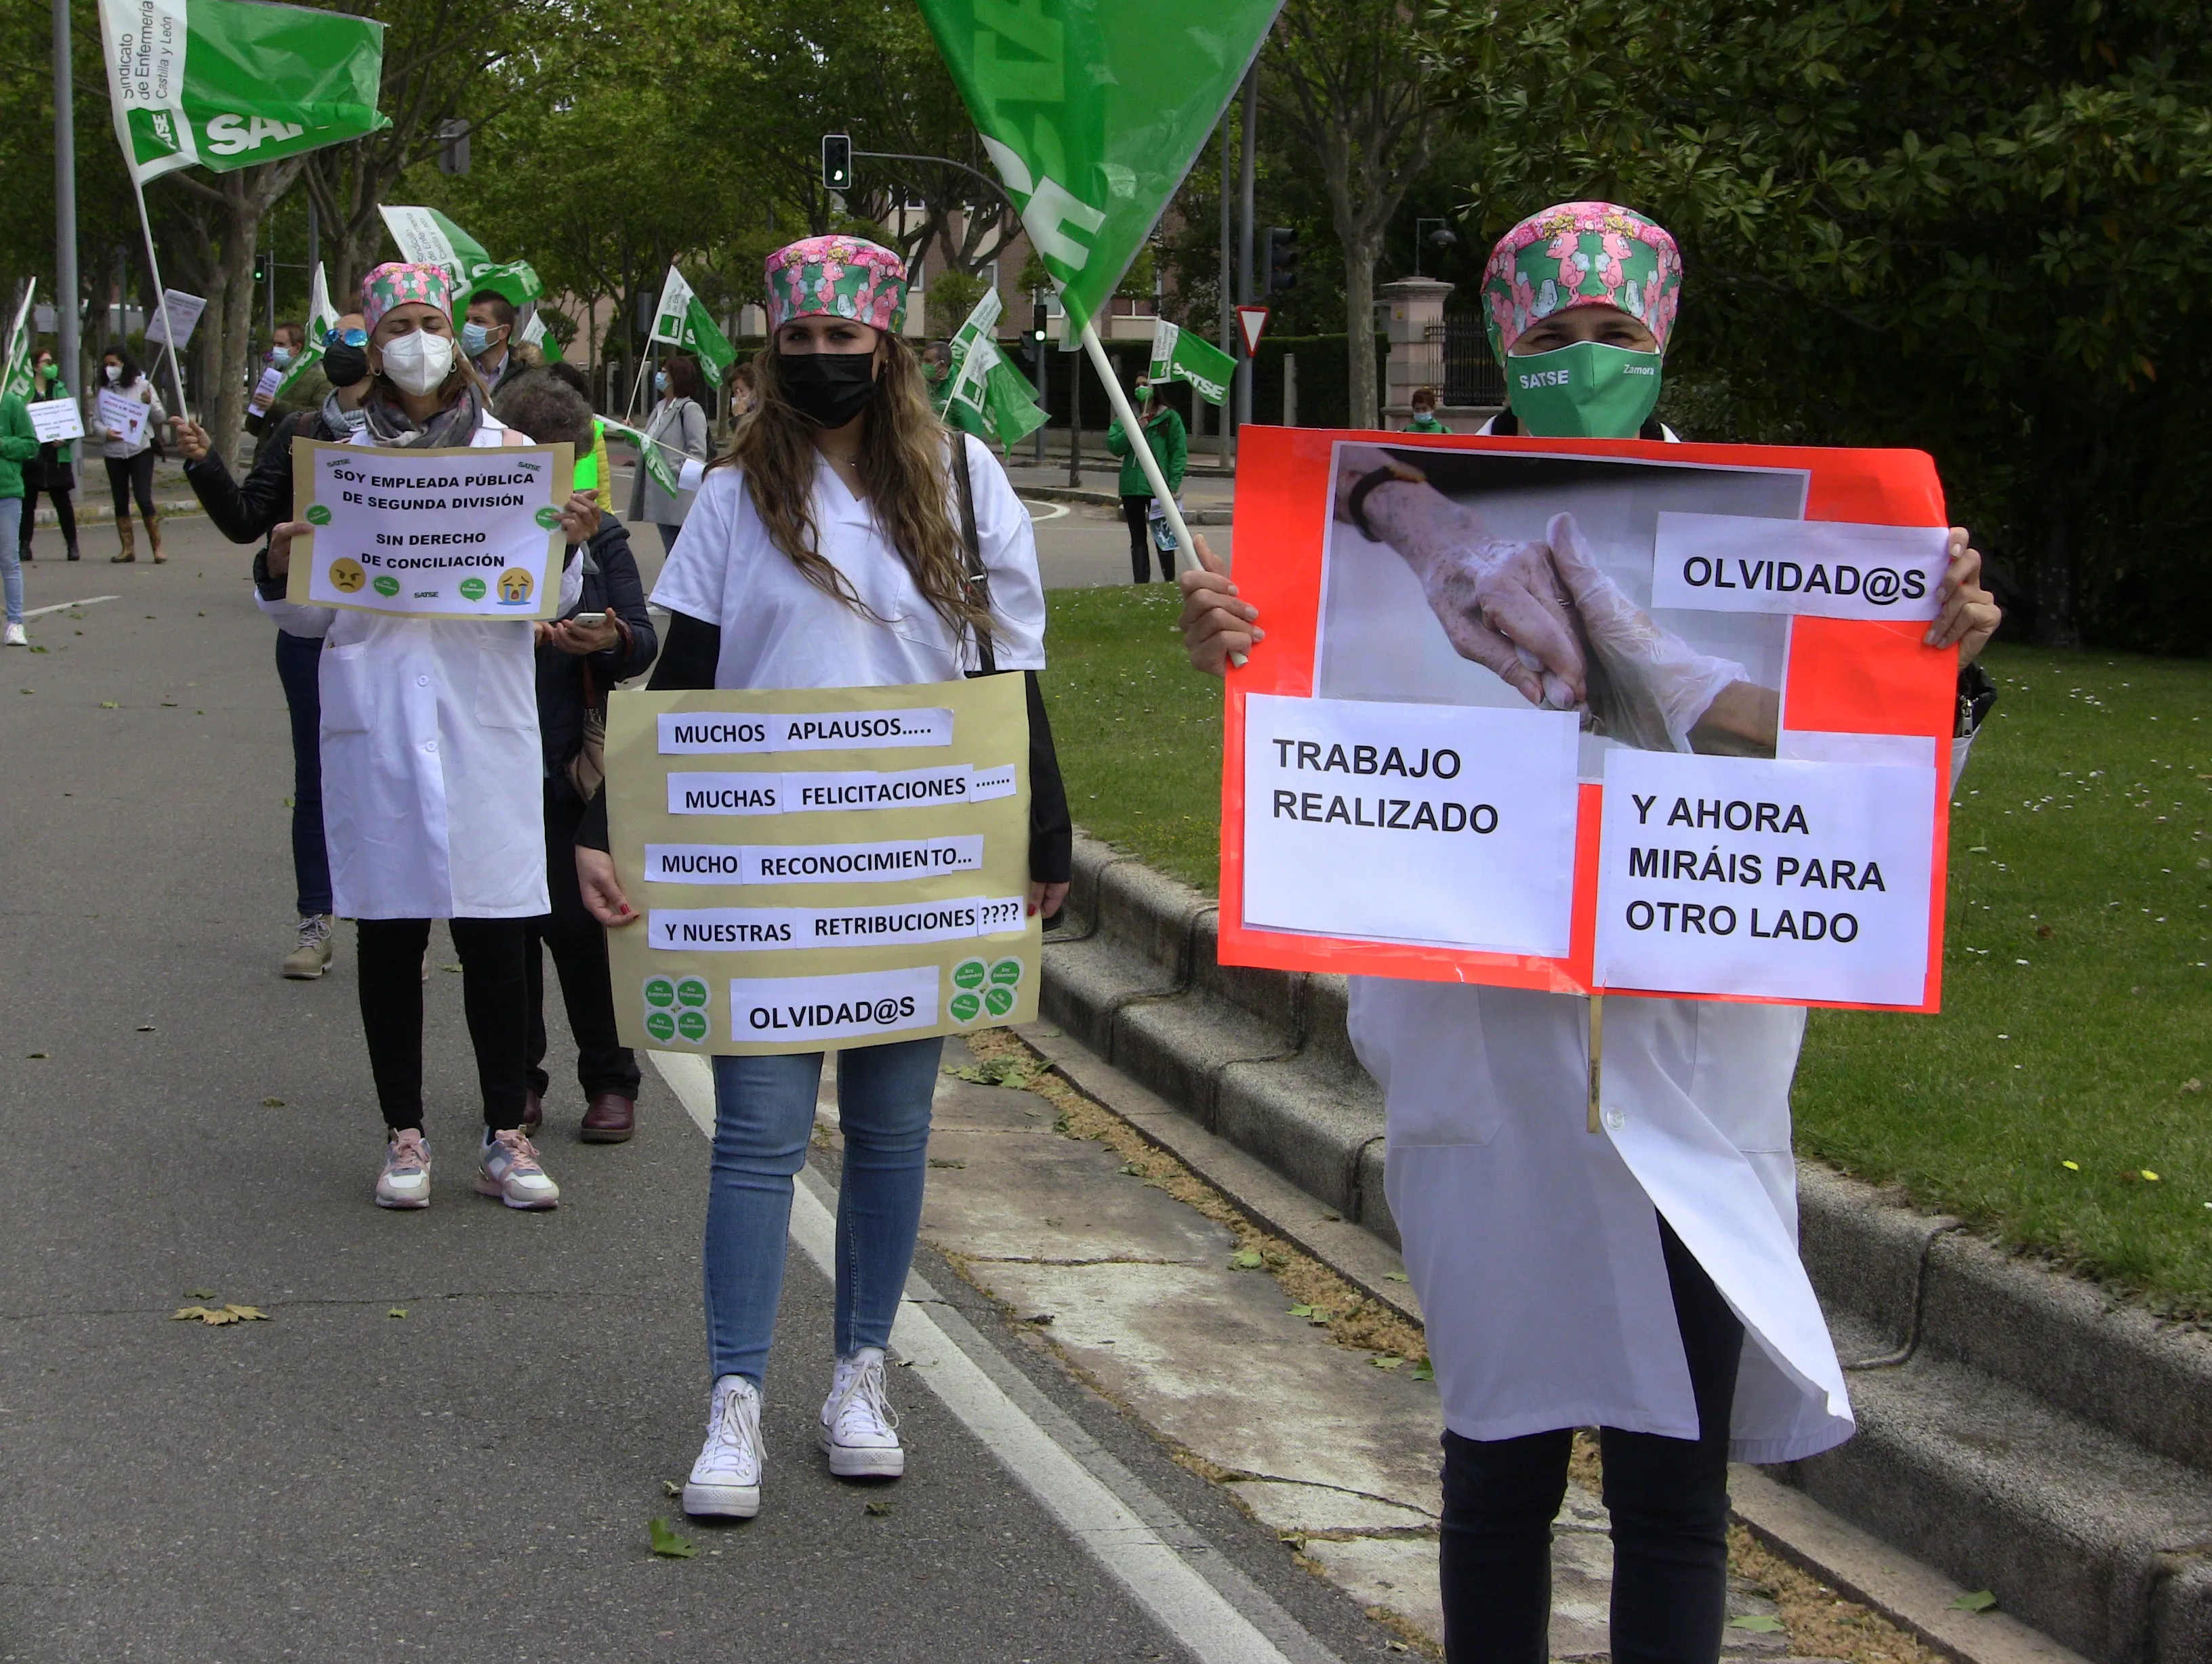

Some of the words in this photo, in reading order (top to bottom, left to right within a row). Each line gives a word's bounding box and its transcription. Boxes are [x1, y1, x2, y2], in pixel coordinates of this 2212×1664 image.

[135, 1, 153, 77] Enfermería
[160, 16, 172, 44] León
[117, 33, 134, 100] Sindicato
[161, 47, 173, 56] y
[138, 81, 150, 100] de
[156, 59, 169, 99] Castilla
[1519, 369, 1569, 390] SATSE
[1623, 364, 1655, 375] Zamora
[333, 469, 367, 484] SOY
[371, 476, 459, 488] EMPLEADA
[465, 472, 535, 487] PÚBLICA
[342, 491, 363, 505] DE
[367, 496, 447, 510] SEGUNDA
[452, 493, 524, 509] DIVISIÓN
[375, 533, 403, 546] SIN
[409, 533, 487, 545] DERECHO
[361, 553, 382, 566] DE
[386, 553, 505, 569] CONCILIACIÓN
[1683, 556, 1925, 606] OLVIDAD@S
[675, 724, 765, 743] MUCHOS
[1273, 739, 1460, 779] TRABAJO
[686, 789, 776, 809] MUCHAS
[802, 777, 966, 806] FELICITACIONES
[1273, 789, 1498, 834] REALIZADO
[1631, 794, 1657, 825] Y
[1666, 797, 1809, 835] AHORA
[662, 855, 738, 873] MUCHO
[761, 848, 972, 876] RECONOCIMIENTO...
[1629, 845, 1762, 884] MIRÁIS
[1776, 856, 1886, 892] PARA
[665, 923, 677, 941] Y
[683, 923, 792, 942] NUESTRAS
[815, 909, 975, 936] RETRIBUCIONES
[1626, 900, 1736, 936] OTRO
[1750, 908, 1858, 943] LADO
[750, 996, 915, 1029] OLVIDAD@S
